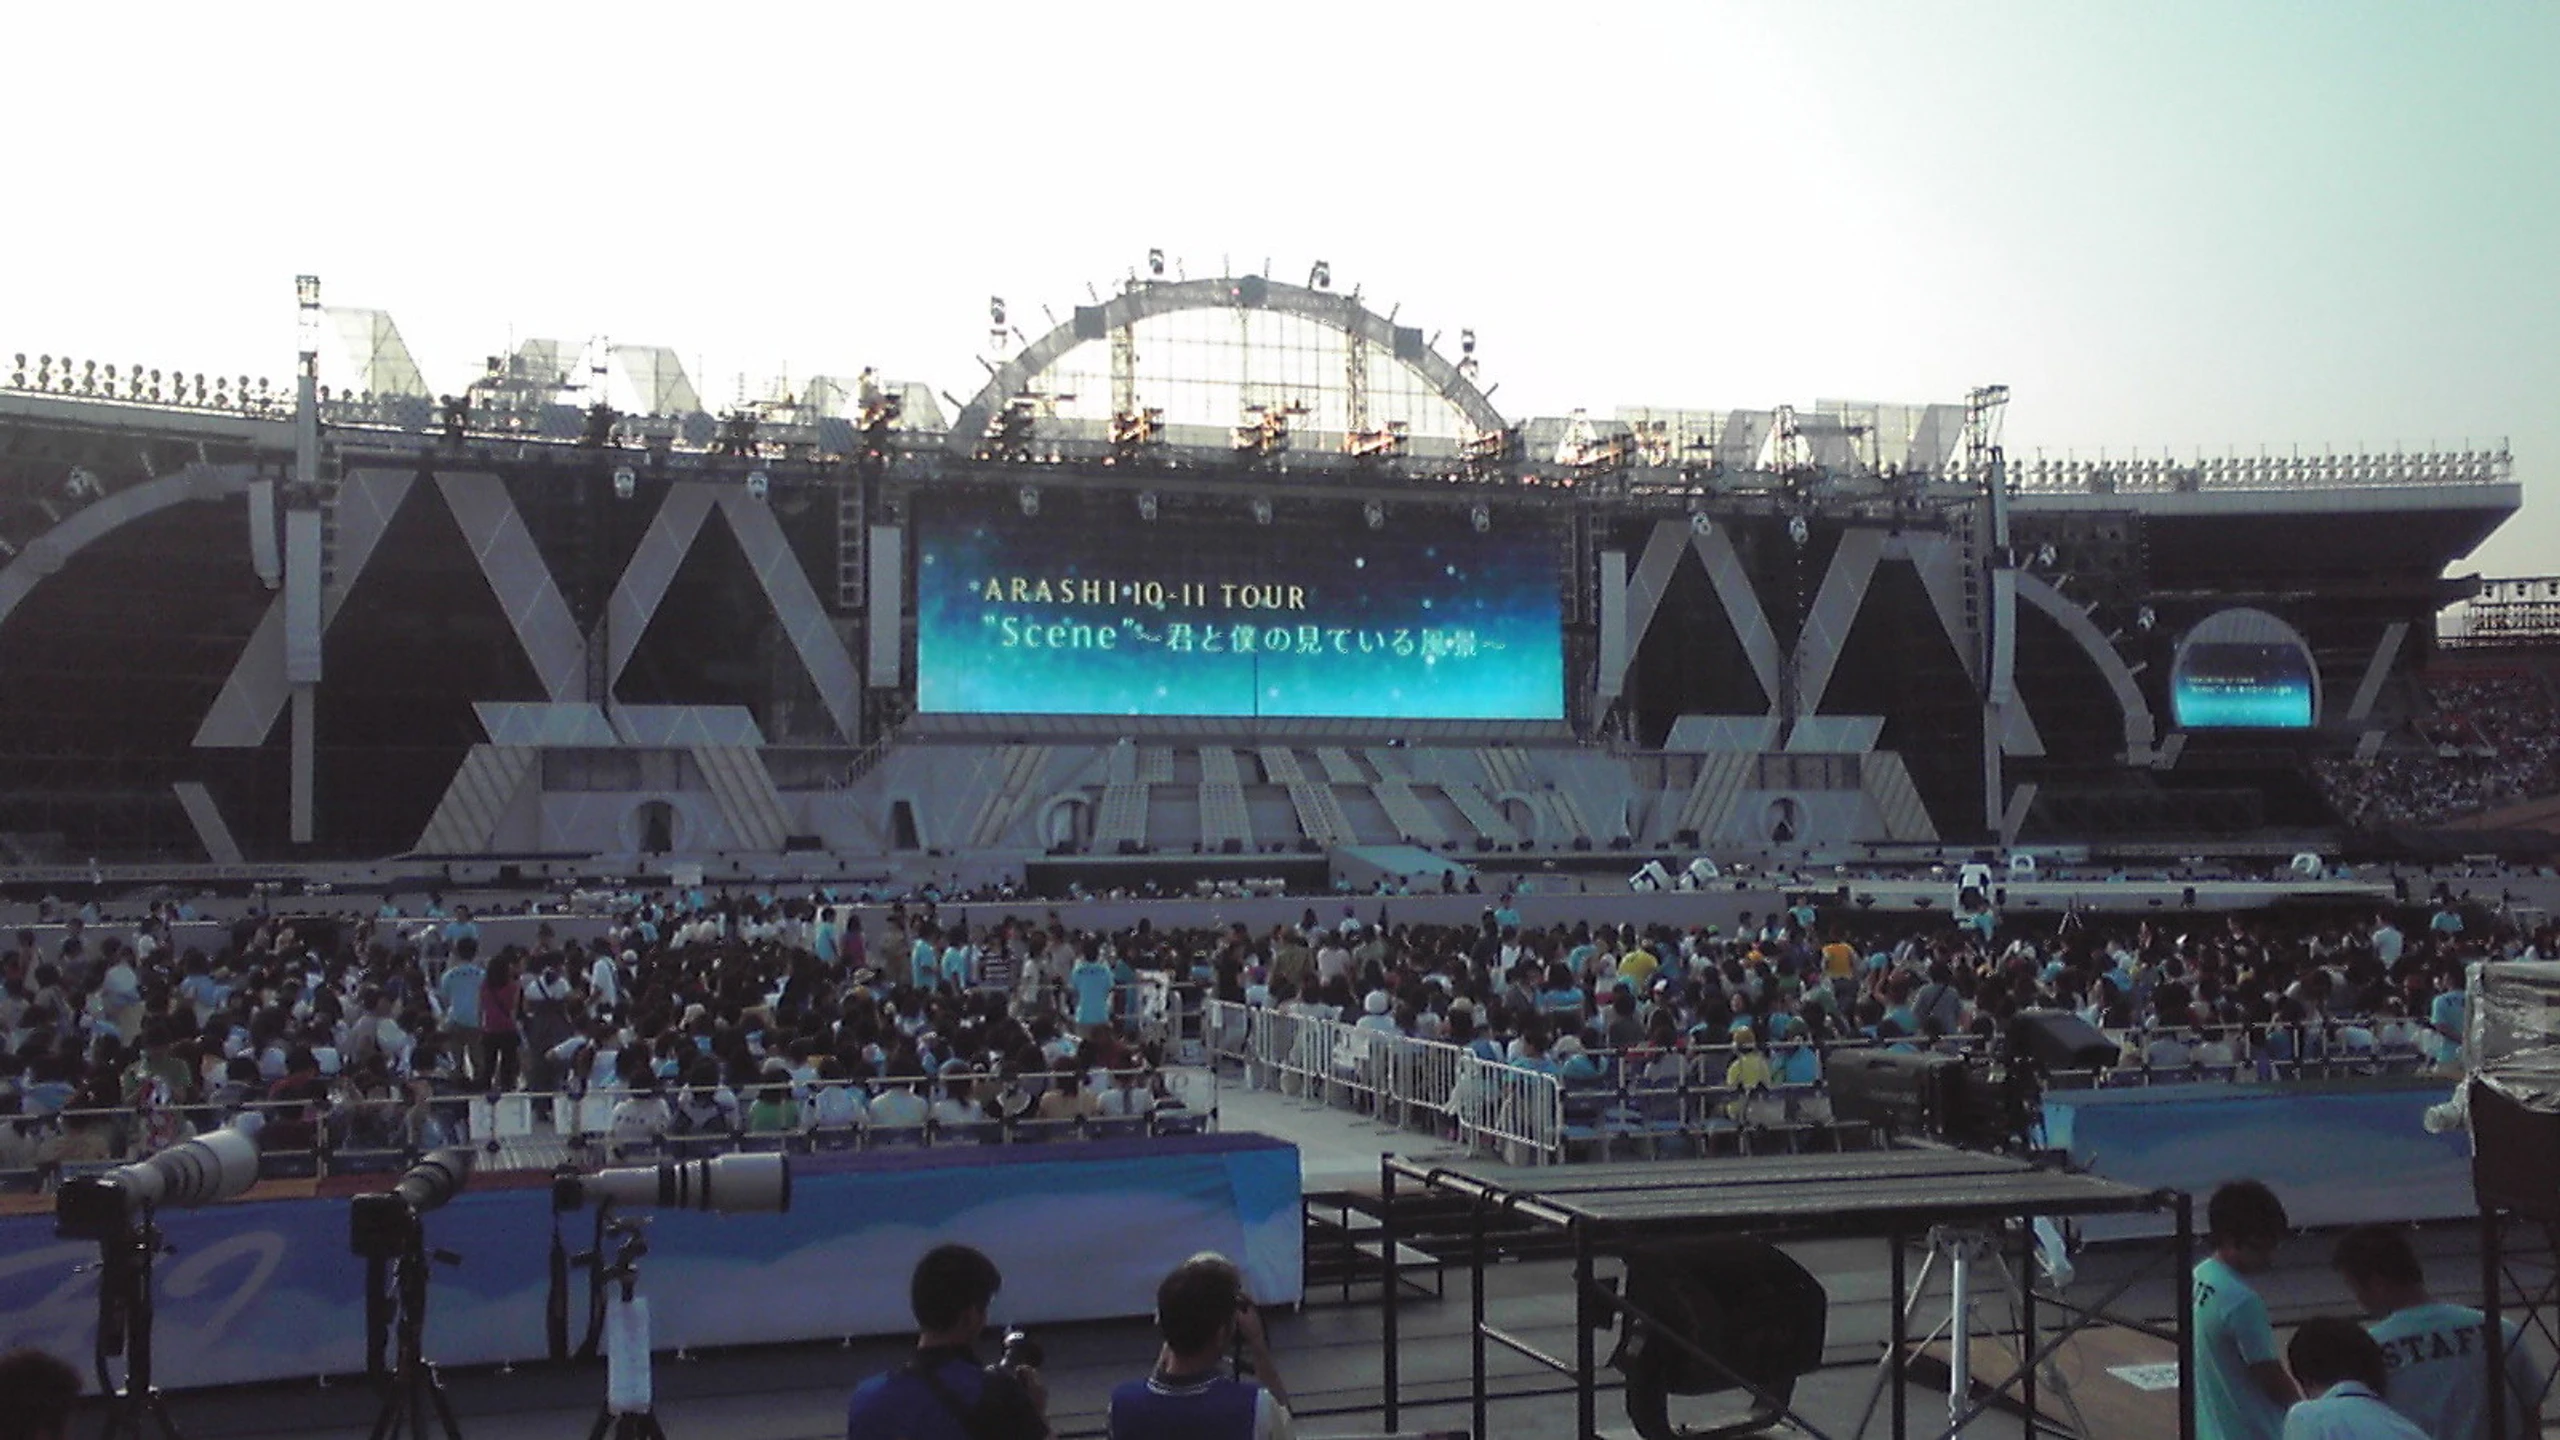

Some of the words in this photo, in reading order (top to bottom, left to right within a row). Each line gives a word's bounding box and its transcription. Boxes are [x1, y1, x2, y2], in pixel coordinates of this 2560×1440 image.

[985, 577, 1117, 605] ARASHI
[1220, 583, 1305, 610] TOUR
[2381, 1324, 2484, 1369] STAF
